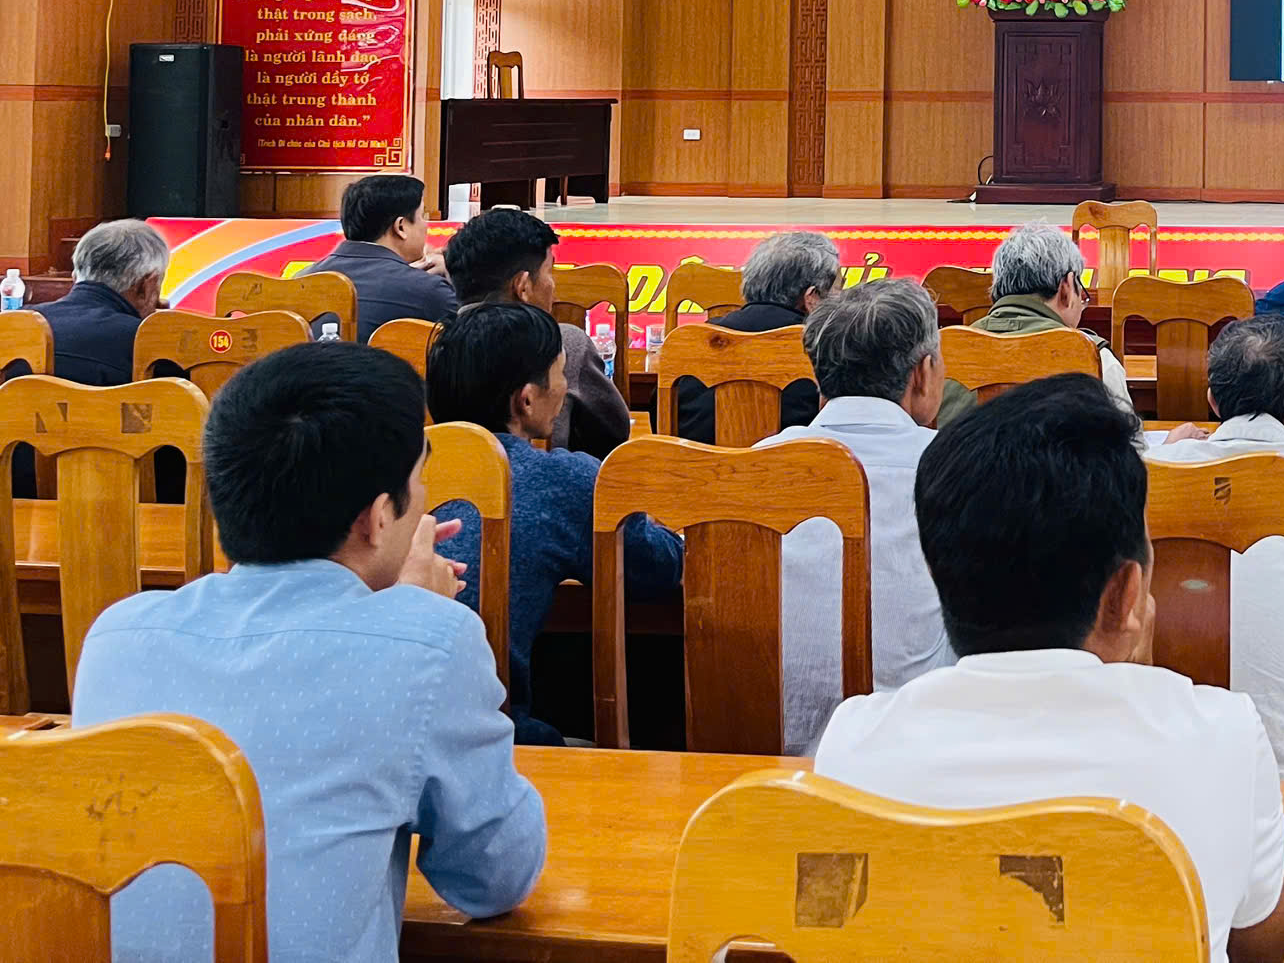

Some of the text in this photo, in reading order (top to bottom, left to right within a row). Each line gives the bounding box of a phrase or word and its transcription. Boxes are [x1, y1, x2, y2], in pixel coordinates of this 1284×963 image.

[257, 7, 335, 23] thật trong
[256, 29, 333, 43] phải xứng
[245, 49, 345, 65] là người lãnh
[257, 70, 348, 86] là người đầy
[247, 93, 376, 108] thật trung thành
[254, 113, 281, 126] của
[285, 114, 324, 126] nhân
